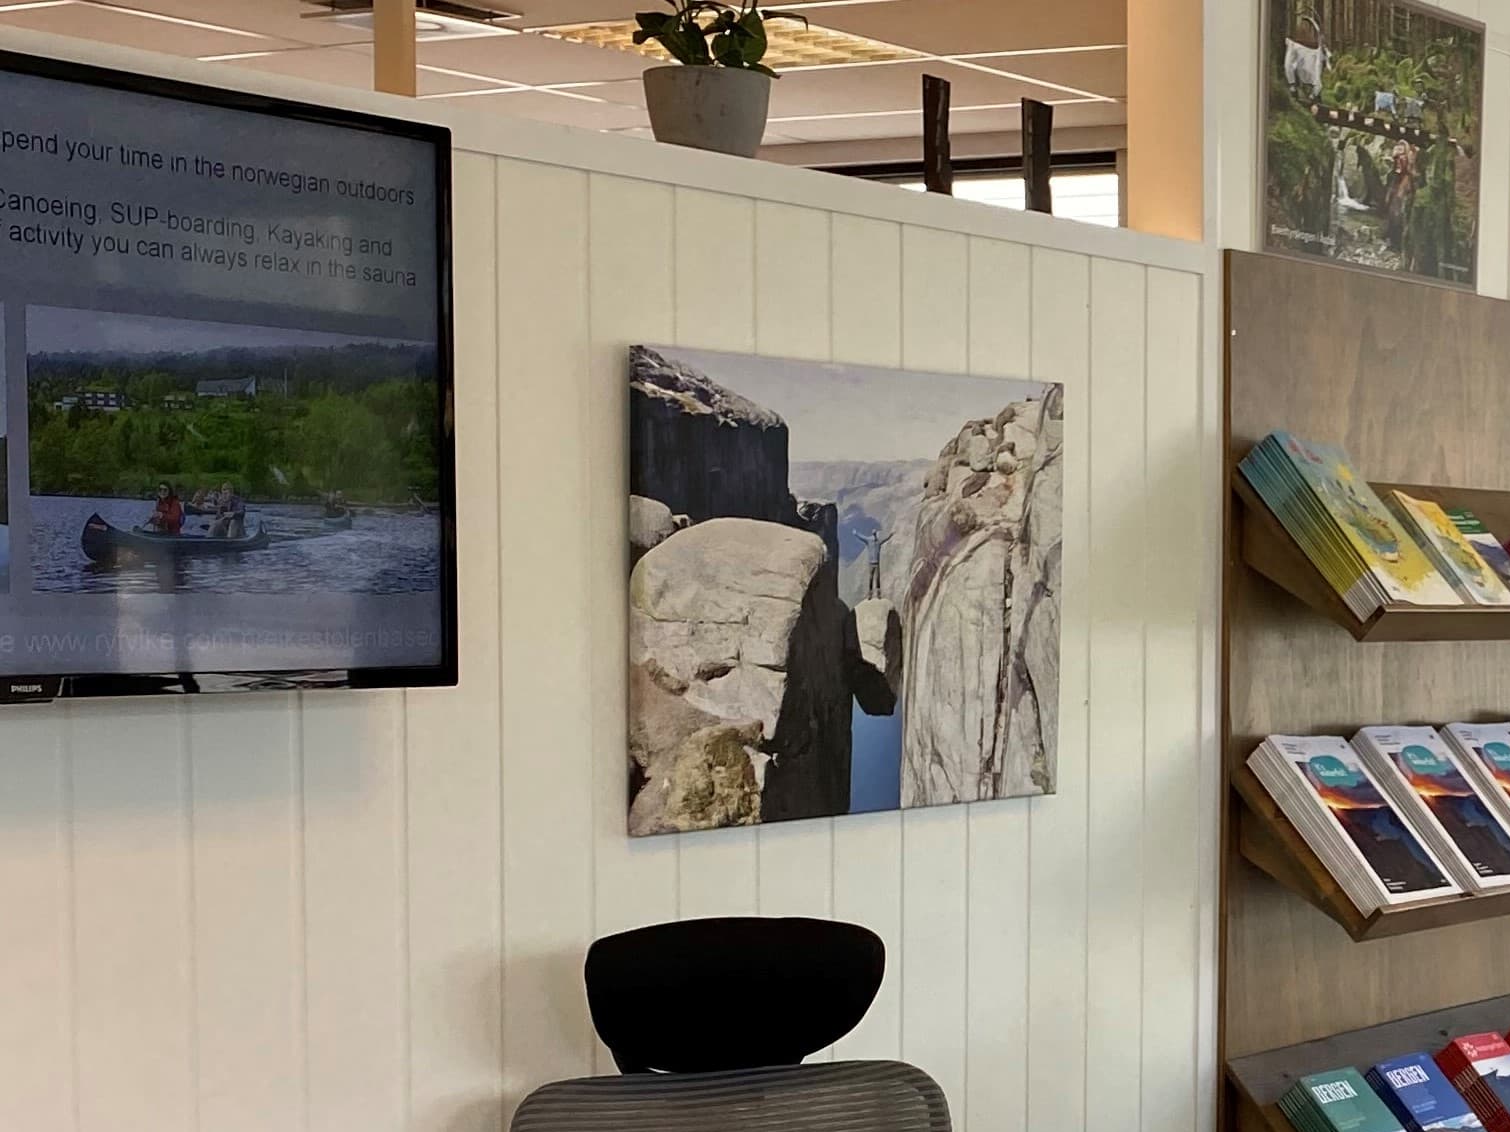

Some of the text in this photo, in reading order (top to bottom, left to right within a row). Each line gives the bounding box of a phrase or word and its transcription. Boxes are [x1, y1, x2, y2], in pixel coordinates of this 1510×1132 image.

[66, 139, 113, 163] your
[120, 143, 163, 169] time
[170, 155, 188, 173] in
[195, 154, 225, 178] the
[232, 164, 330, 194] norwegian
[336, 179, 415, 206] outdoors
[268, 224, 352, 257] Kayaking
[359, 237, 392, 257] and
[9, 224, 416, 287] activity you can always relax in the sauna
[11, 684, 42, 693] PHILIPS
[1386, 1064, 1430, 1089] BERGEN
[1311, 1079, 1358, 1104] BERGEN
